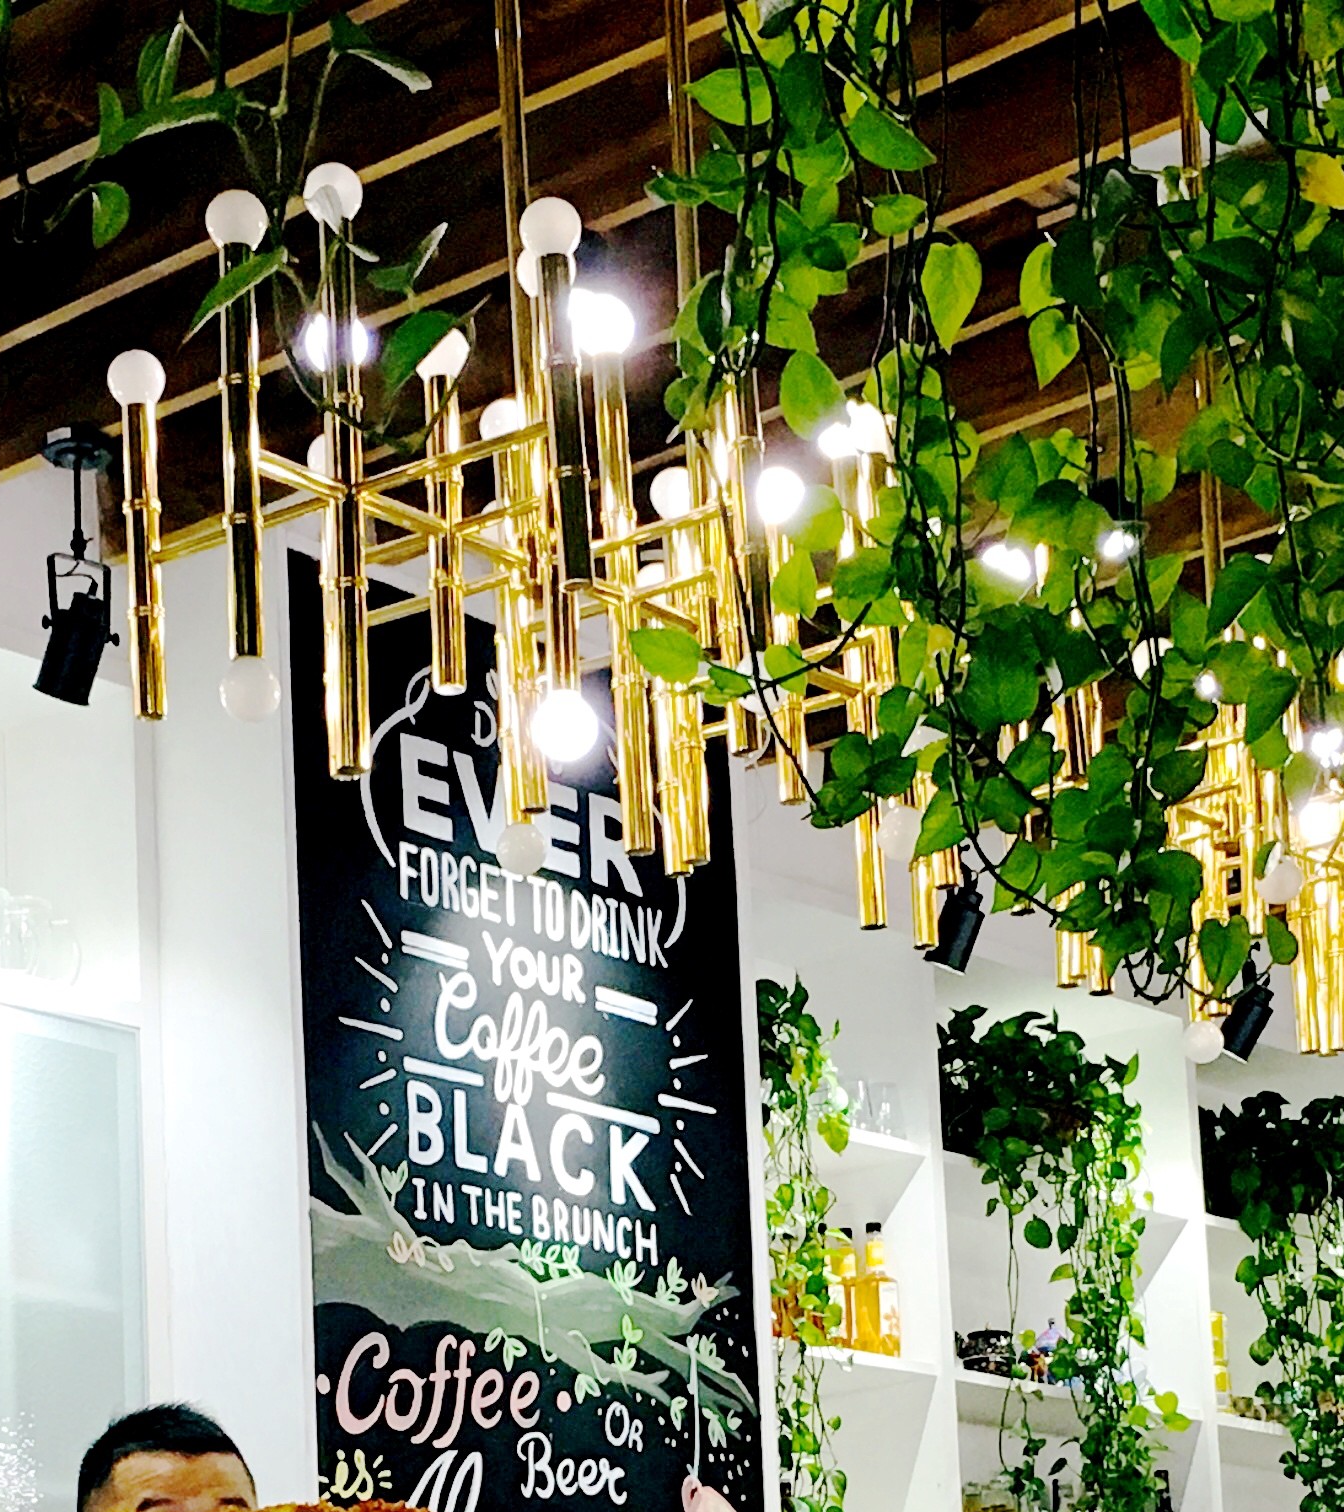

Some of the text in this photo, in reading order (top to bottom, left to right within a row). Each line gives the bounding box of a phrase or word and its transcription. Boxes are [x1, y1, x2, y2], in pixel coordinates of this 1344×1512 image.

[399, 732, 644, 897] EVER
[398, 840, 669, 969] FORGET TO DRINK
[482, 930, 587, 1003] YOUR
[434, 971, 606, 1106] Coffee
[406, 1079, 657, 1212] BLACK
[411, 1178, 658, 1267] IN THE BRUNCH
[335, 1331, 541, 1449] Coffee
[517, 1431, 627, 1505] Beer
